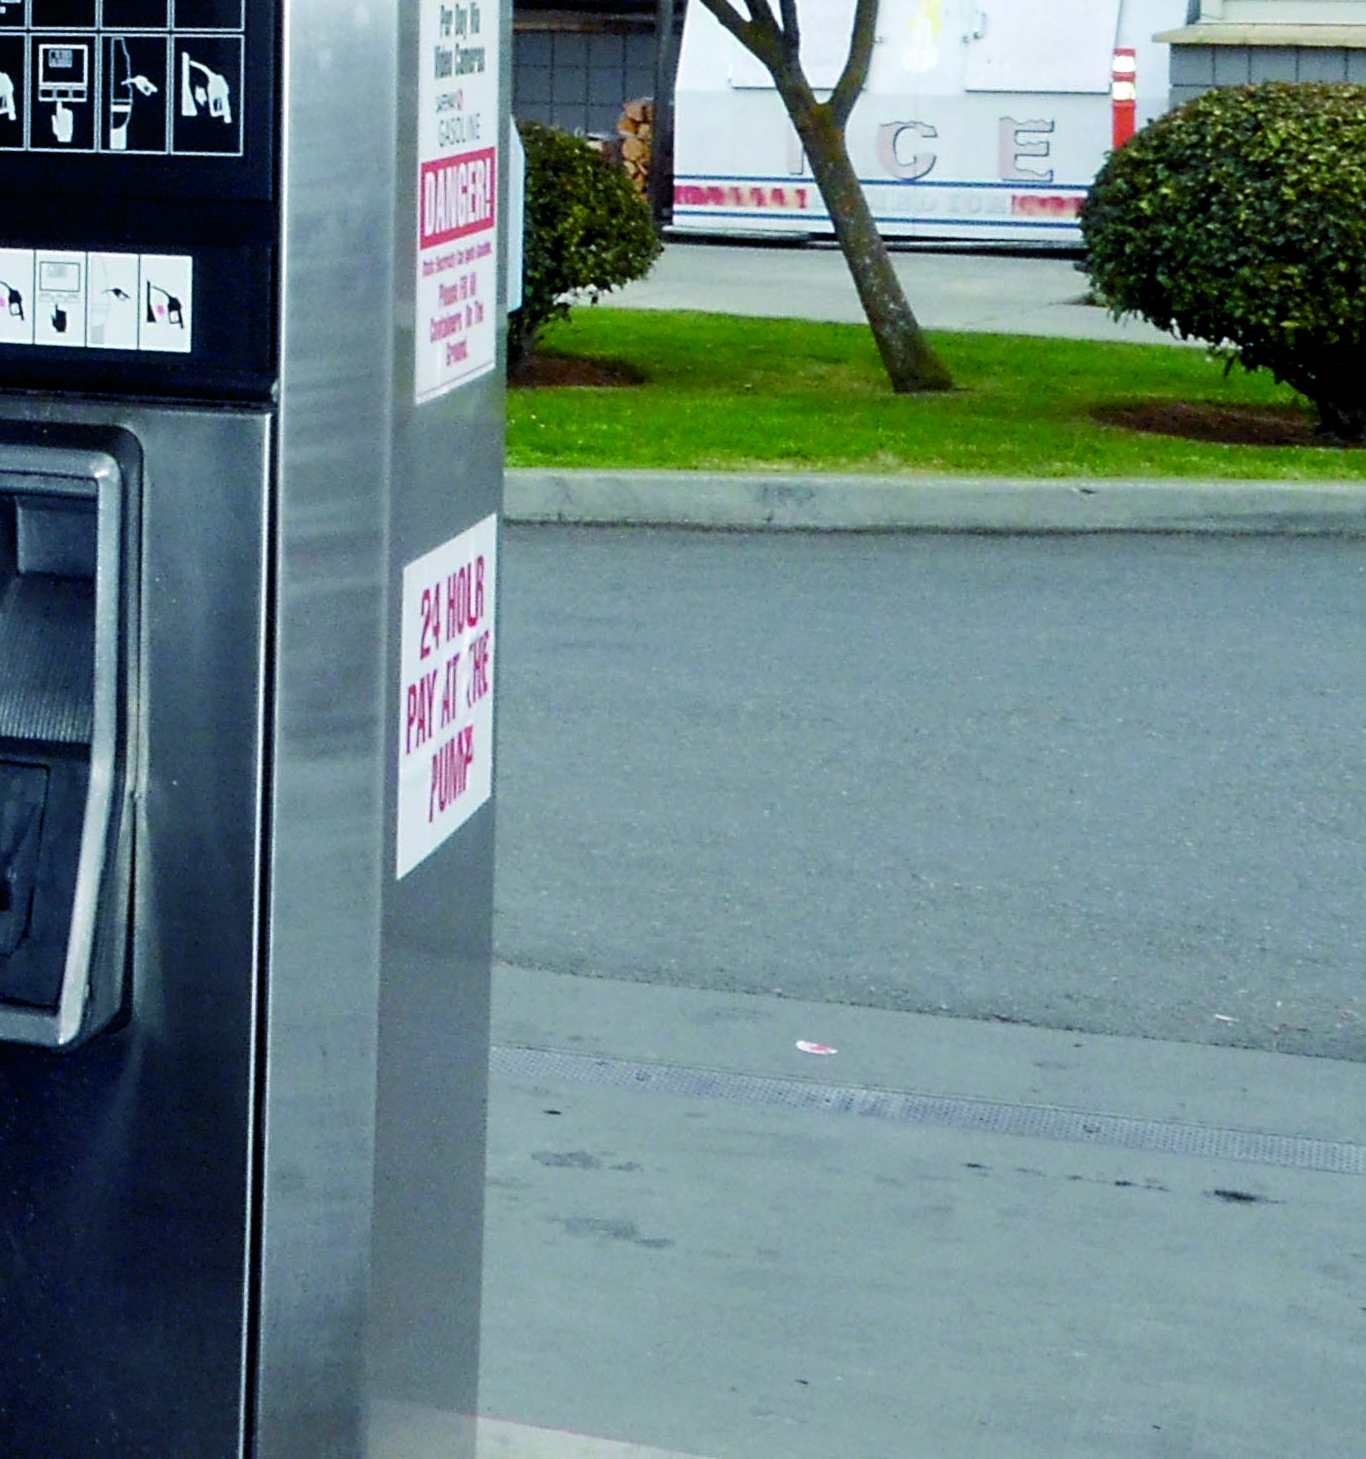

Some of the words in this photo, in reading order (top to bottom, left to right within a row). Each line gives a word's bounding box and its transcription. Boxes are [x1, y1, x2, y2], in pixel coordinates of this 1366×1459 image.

[438, 112, 481, 147] GASOLINE
[425, 158, 491, 236] DANGER!
[421, 588, 440, 660] 24
[447, 555, 484, 642] HOUR
[407, 668, 437, 755] PAY
[441, 652, 460, 729] AT
